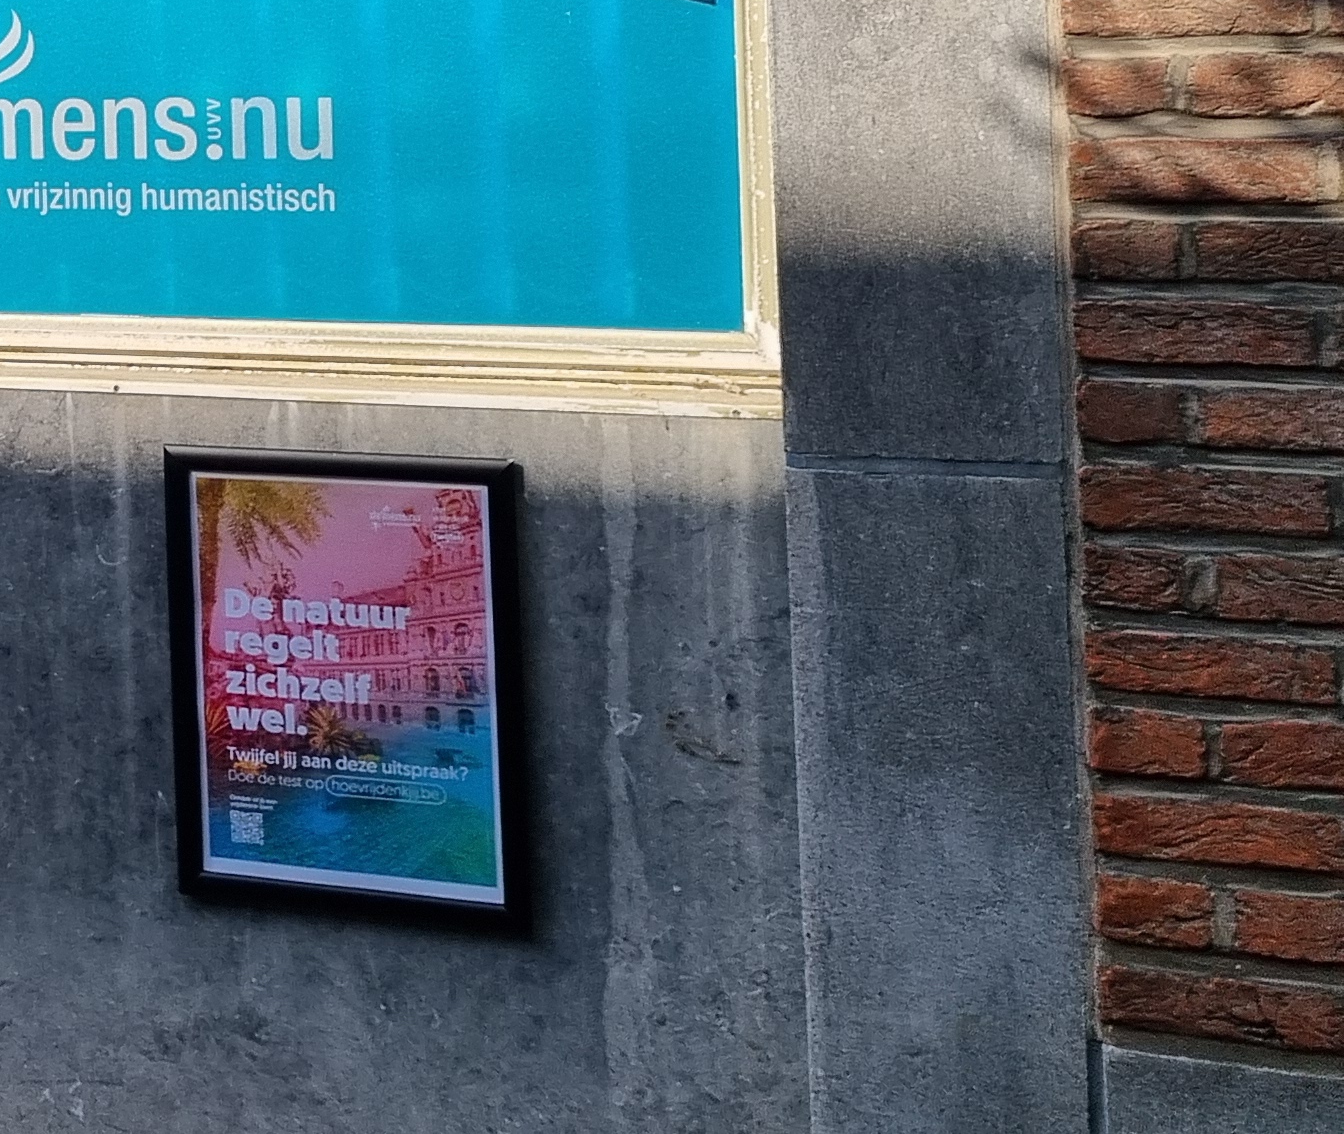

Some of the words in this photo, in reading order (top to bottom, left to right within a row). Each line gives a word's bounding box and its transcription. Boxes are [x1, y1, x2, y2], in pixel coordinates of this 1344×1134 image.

[6, 180, 132, 218] vrijzinnig
[140, 180, 337, 214] humanistisch
[223, 588, 274, 620] De
[283, 595, 412, 630] natuur
[225, 627, 341, 666] regelt
[225, 663, 373, 706] zichzelf
[226, 701, 309, 736] wel.
[226, 745, 280, 769] Twijfel
[282, 751, 297, 771] jij
[301, 755, 332, 769] aan
[335, 756, 378, 773] deze
[381, 760, 469, 781] uitspraak?
[228, 769, 255, 783] Doe
[257, 770, 276, 785] de
[278, 774, 302, 788] test
[305, 779, 324, 792] op
